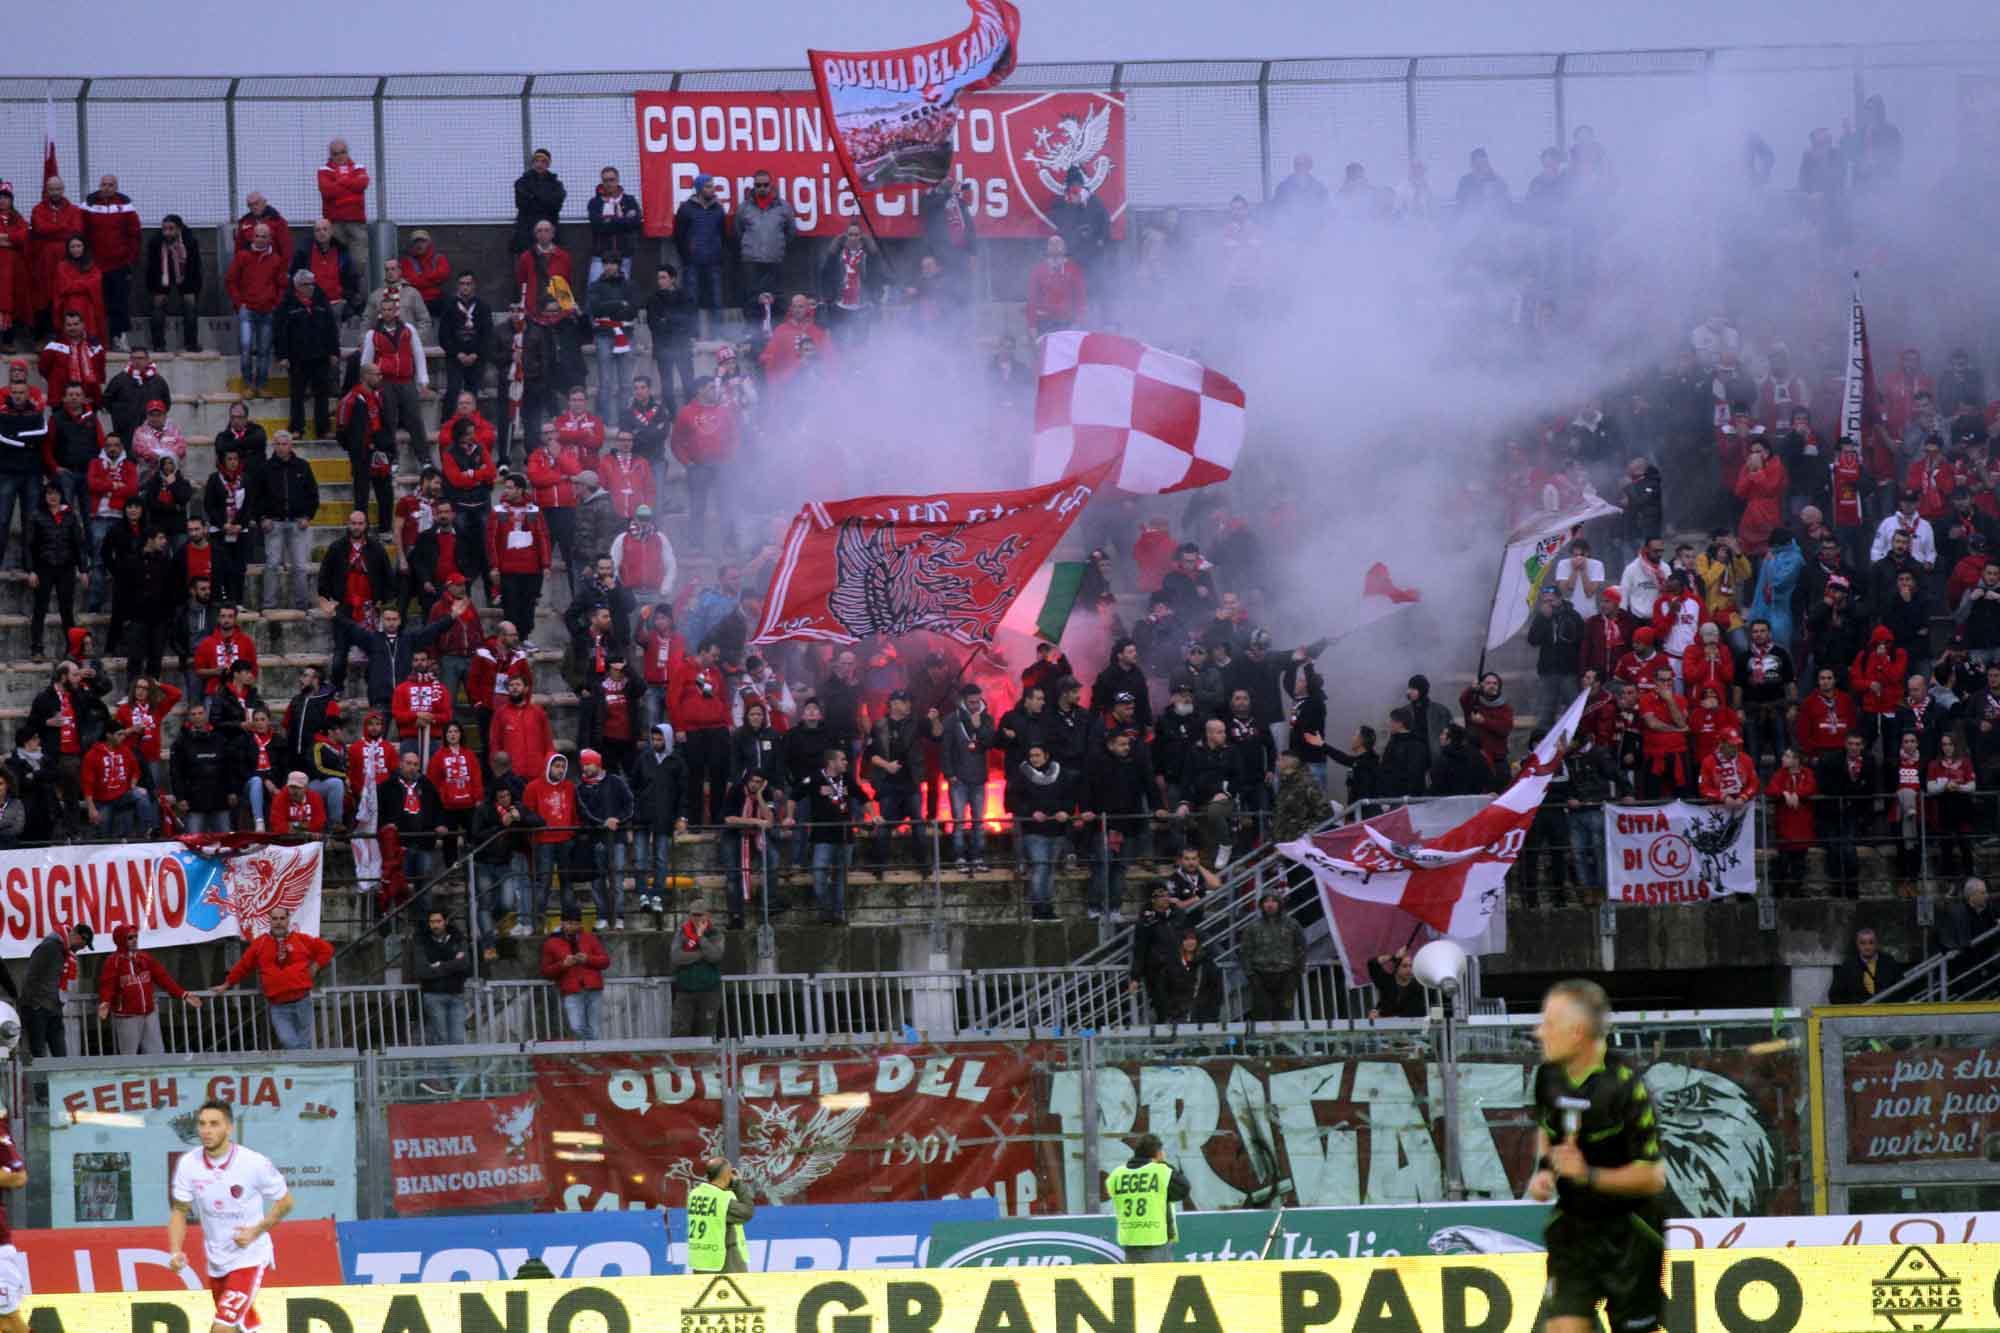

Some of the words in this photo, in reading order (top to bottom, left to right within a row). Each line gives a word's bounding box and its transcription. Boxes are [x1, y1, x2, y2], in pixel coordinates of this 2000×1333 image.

[823, 58, 910, 93] QUELLI
[912, 47, 956, 90] DEL
[1617, 810, 1670, 834] CITTÀ
[1624, 849, 1643, 871] DI
[0, 856, 188, 940] SIGNANO
[1622, 880, 1711, 905] CASTELLO
[876, 1055, 991, 1103] DEL
[63, 1076, 180, 1124] FEEH
[1871, 1094, 1933, 1120] non
[393, 1135, 478, 1160] PARMA
[1867, 1121, 1980, 1157] venire!
[396, 1163, 545, 1196] BIANCOROSSA
[1114, 1173, 1160, 1195] LEGEA
[1123, 1198, 1148, 1218] 38
[222, 1290, 249, 1310] 27
[1872, 1286, 1961, 1298] GRANA
[1872, 1297, 1962, 1309] PADANO
